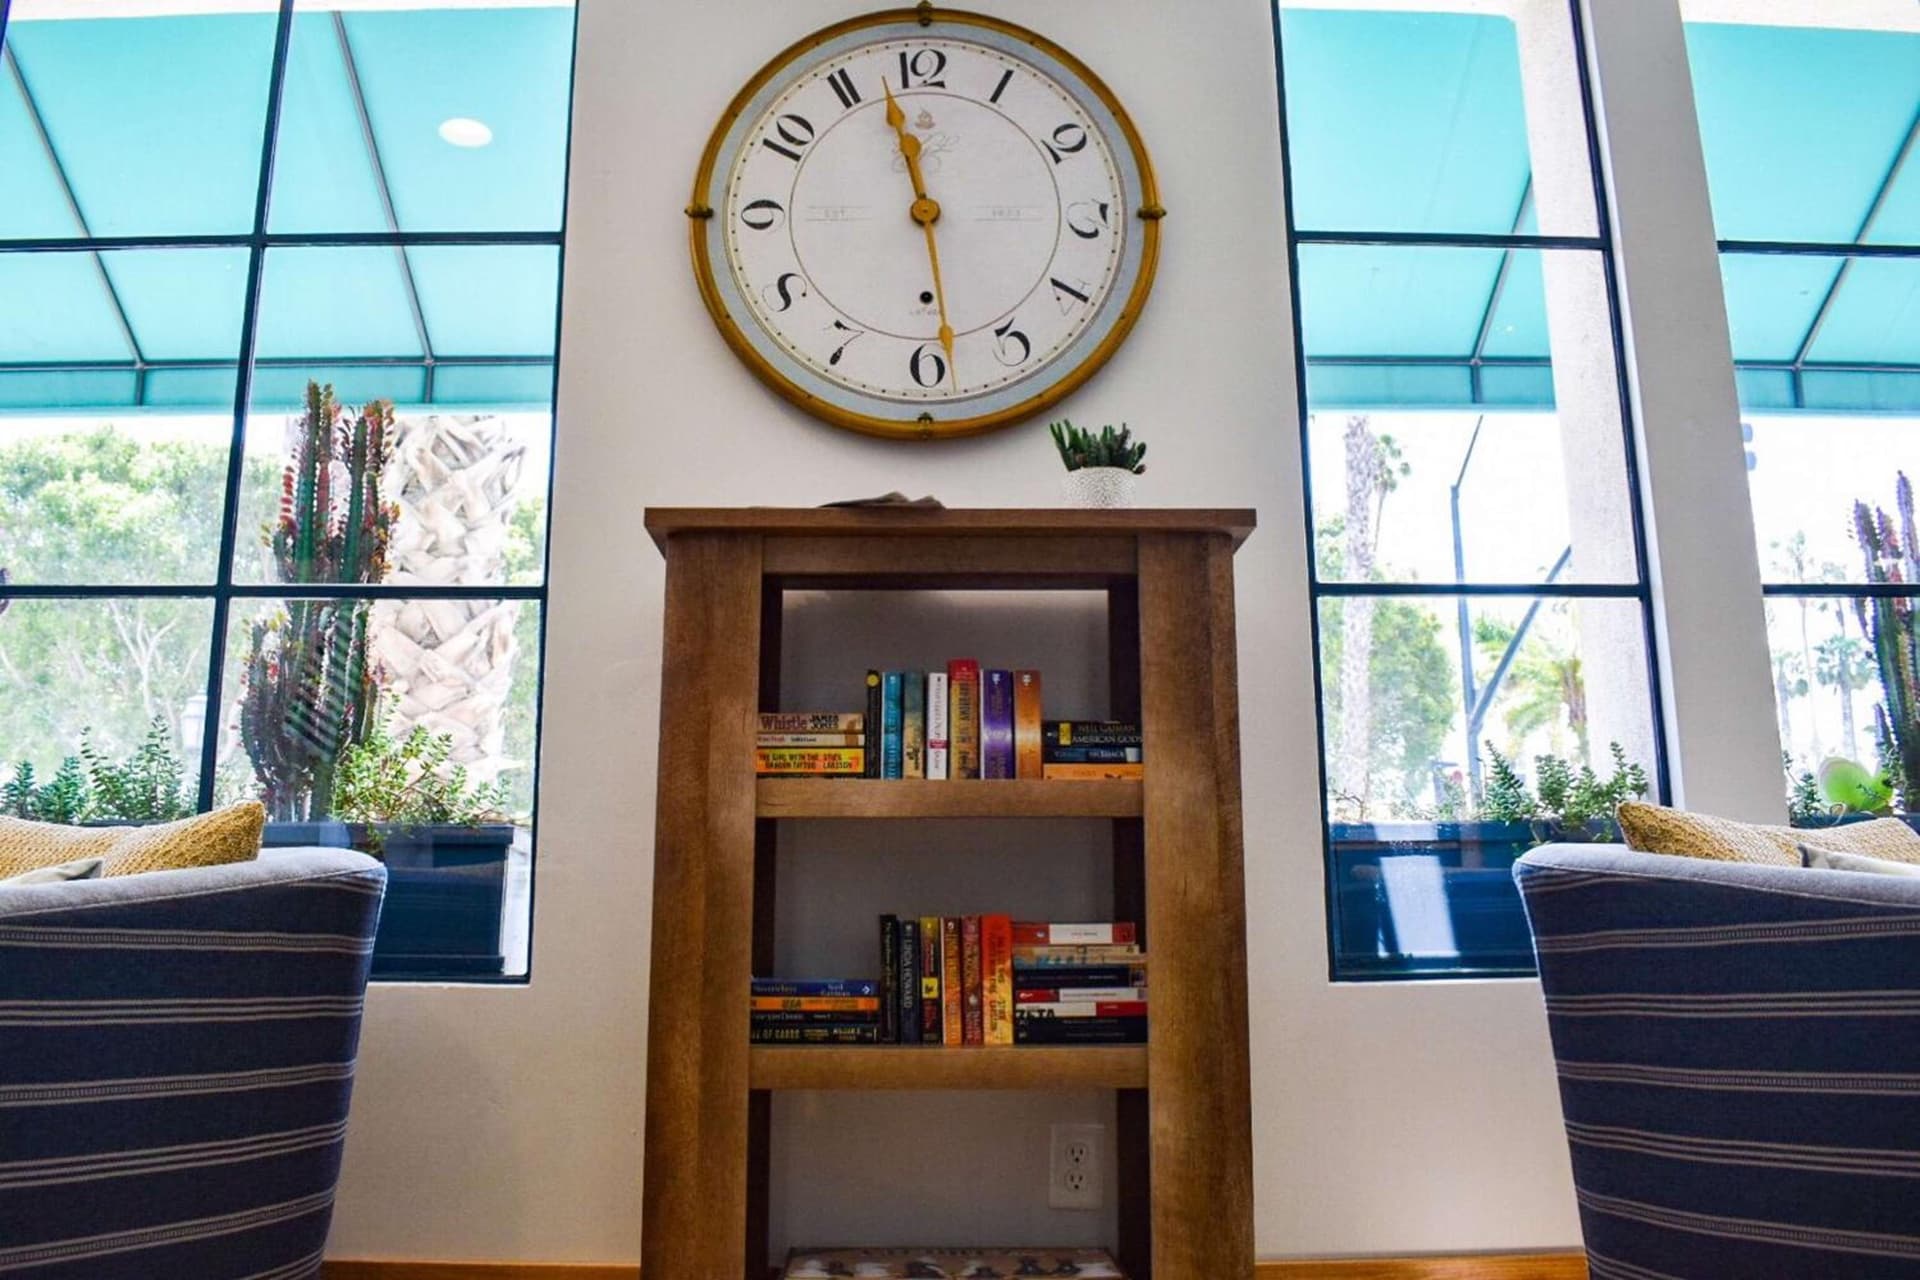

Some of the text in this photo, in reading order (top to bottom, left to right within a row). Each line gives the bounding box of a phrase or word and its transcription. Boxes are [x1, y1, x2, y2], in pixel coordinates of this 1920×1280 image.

[900, 48, 947, 90] 12
[989, 68, 1015, 104] 1
[762, 113, 815, 163] 10
[1040, 122, 1088, 165] 2
[741, 199, 786, 231] 9
[1067, 198, 1110, 240] 3
[762, 271, 808, 313] 8
[1049, 276, 1092, 317] 4
[822, 319, 865, 366] 7
[993, 317, 1031, 367] 5
[909, 343, 947, 388] 6
[760, 714, 807, 731] Whistle
[809, 714, 840, 722] JAMES
[1071, 735, 1144, 744] AMERICAN GODS
[903, 967, 913, 1009] HOWARD
